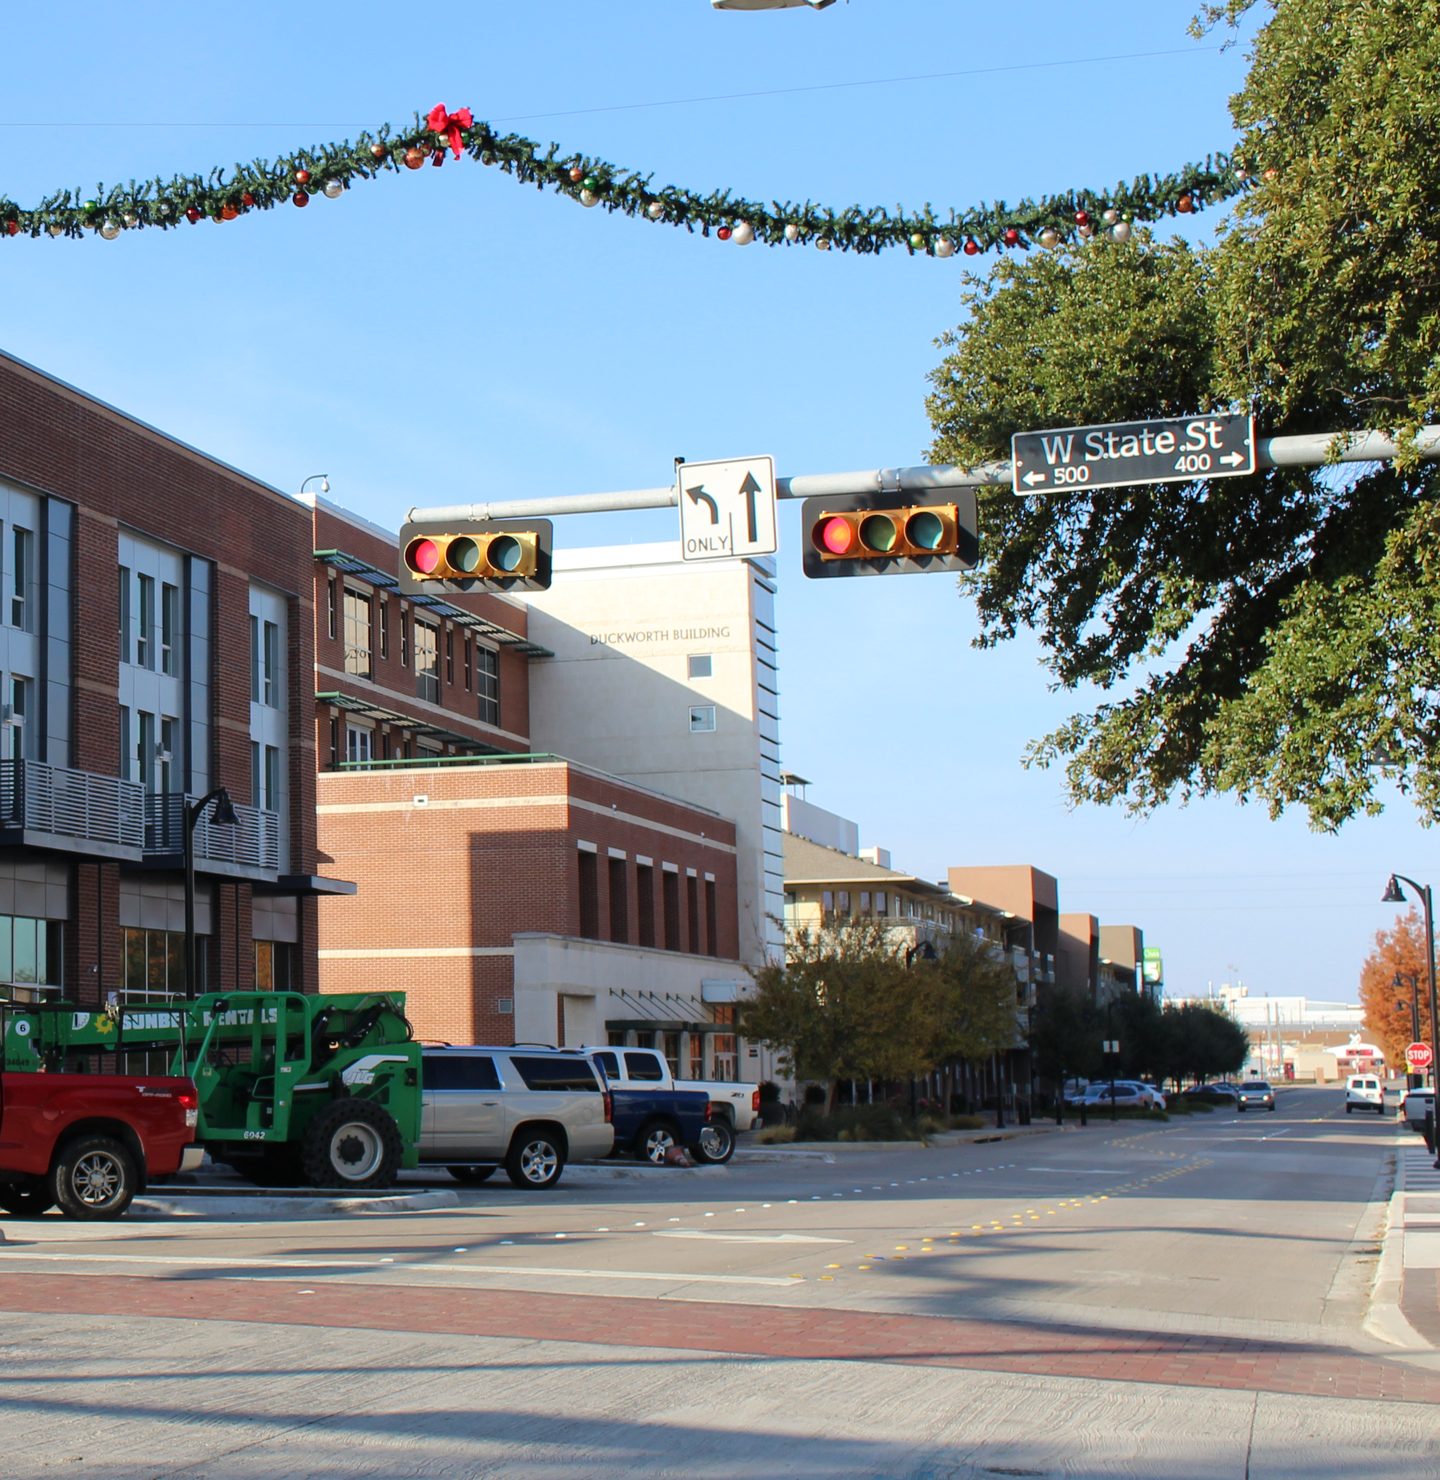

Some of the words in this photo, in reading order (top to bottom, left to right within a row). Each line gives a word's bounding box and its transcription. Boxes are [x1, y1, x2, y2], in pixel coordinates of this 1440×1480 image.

[1041, 434, 1075, 465] W
[1085, 427, 1176, 462] State
[1185, 420, 1224, 452] St
[1173, 453, 1212, 473] 400
[1054, 465, 1090, 485] 500
[686, 535, 729, 554] ONLY
[590, 630, 670, 646] DUCKWORTH
[673, 626, 731, 641] BUILDING
[19, 1024, 27, 1033] 6
[1407, 1050, 1430, 1061] STOP
